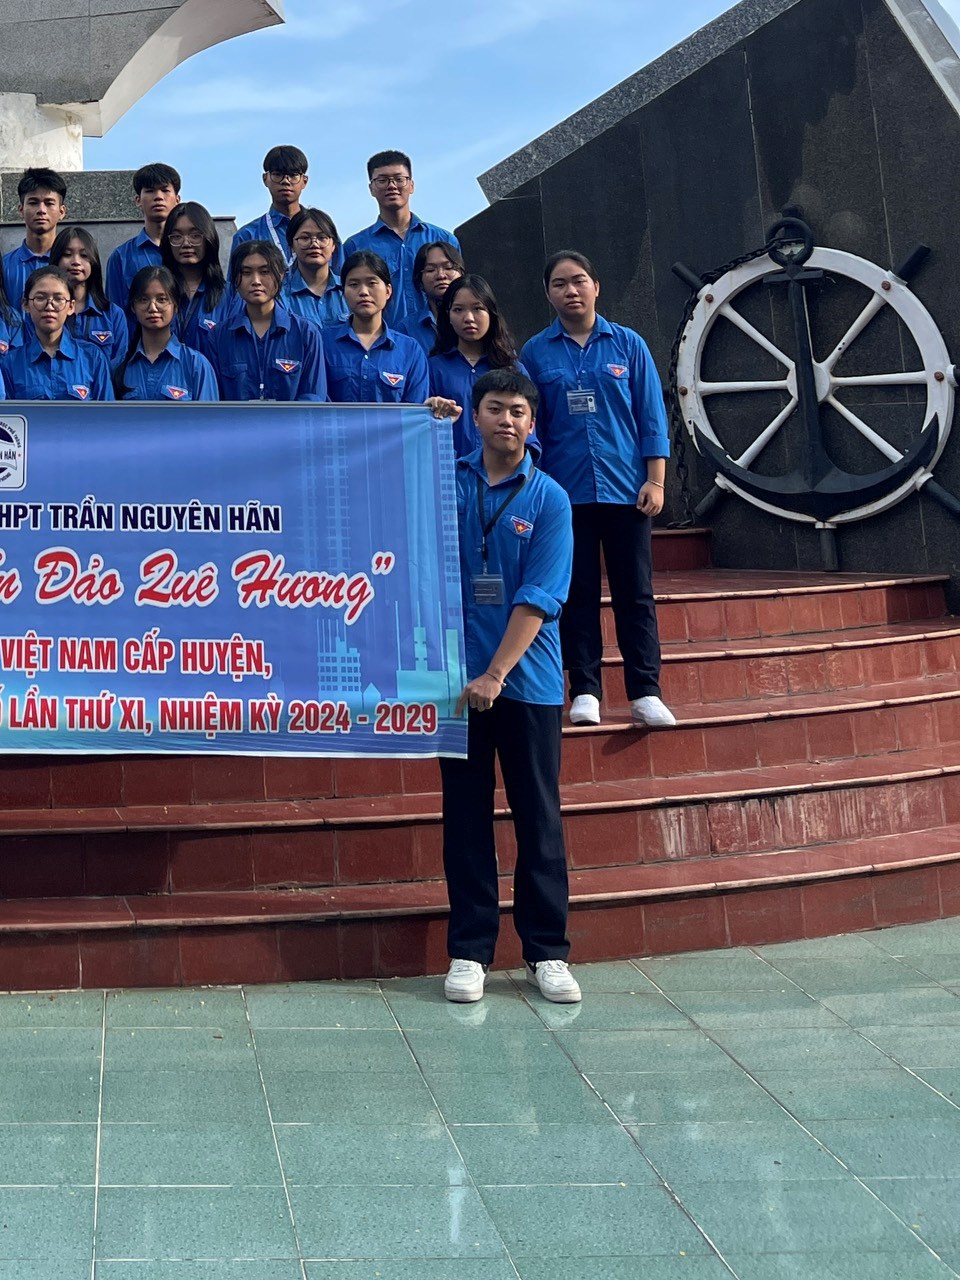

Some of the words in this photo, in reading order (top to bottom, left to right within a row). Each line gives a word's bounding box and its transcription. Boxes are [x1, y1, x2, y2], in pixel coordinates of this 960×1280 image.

[4, 449, 16, 459] HÃN
[51, 495, 113, 531] TRẦN
[121, 500, 221, 531] NGUYÊN
[228, 500, 281, 532] HÃN
[34, 546, 123, 605] Đảo
[136, 549, 219, 606] Quê
[0, 630, 53, 677] VIỆT
[59, 637, 117, 673] NAM
[124, 628, 174, 674] CẤP
[181, 633, 271, 681] HUYỆN,
[9, 686, 58, 731] LẦN
[65, 690, 117, 732] THỨ
[120, 698, 153, 735] XI,
[159, 692, 242, 739] NHIỆM
[249, 693, 283, 733] KỲ
[289, 703, 351, 734] 2024
[374, 703, 437, 735] 2029
